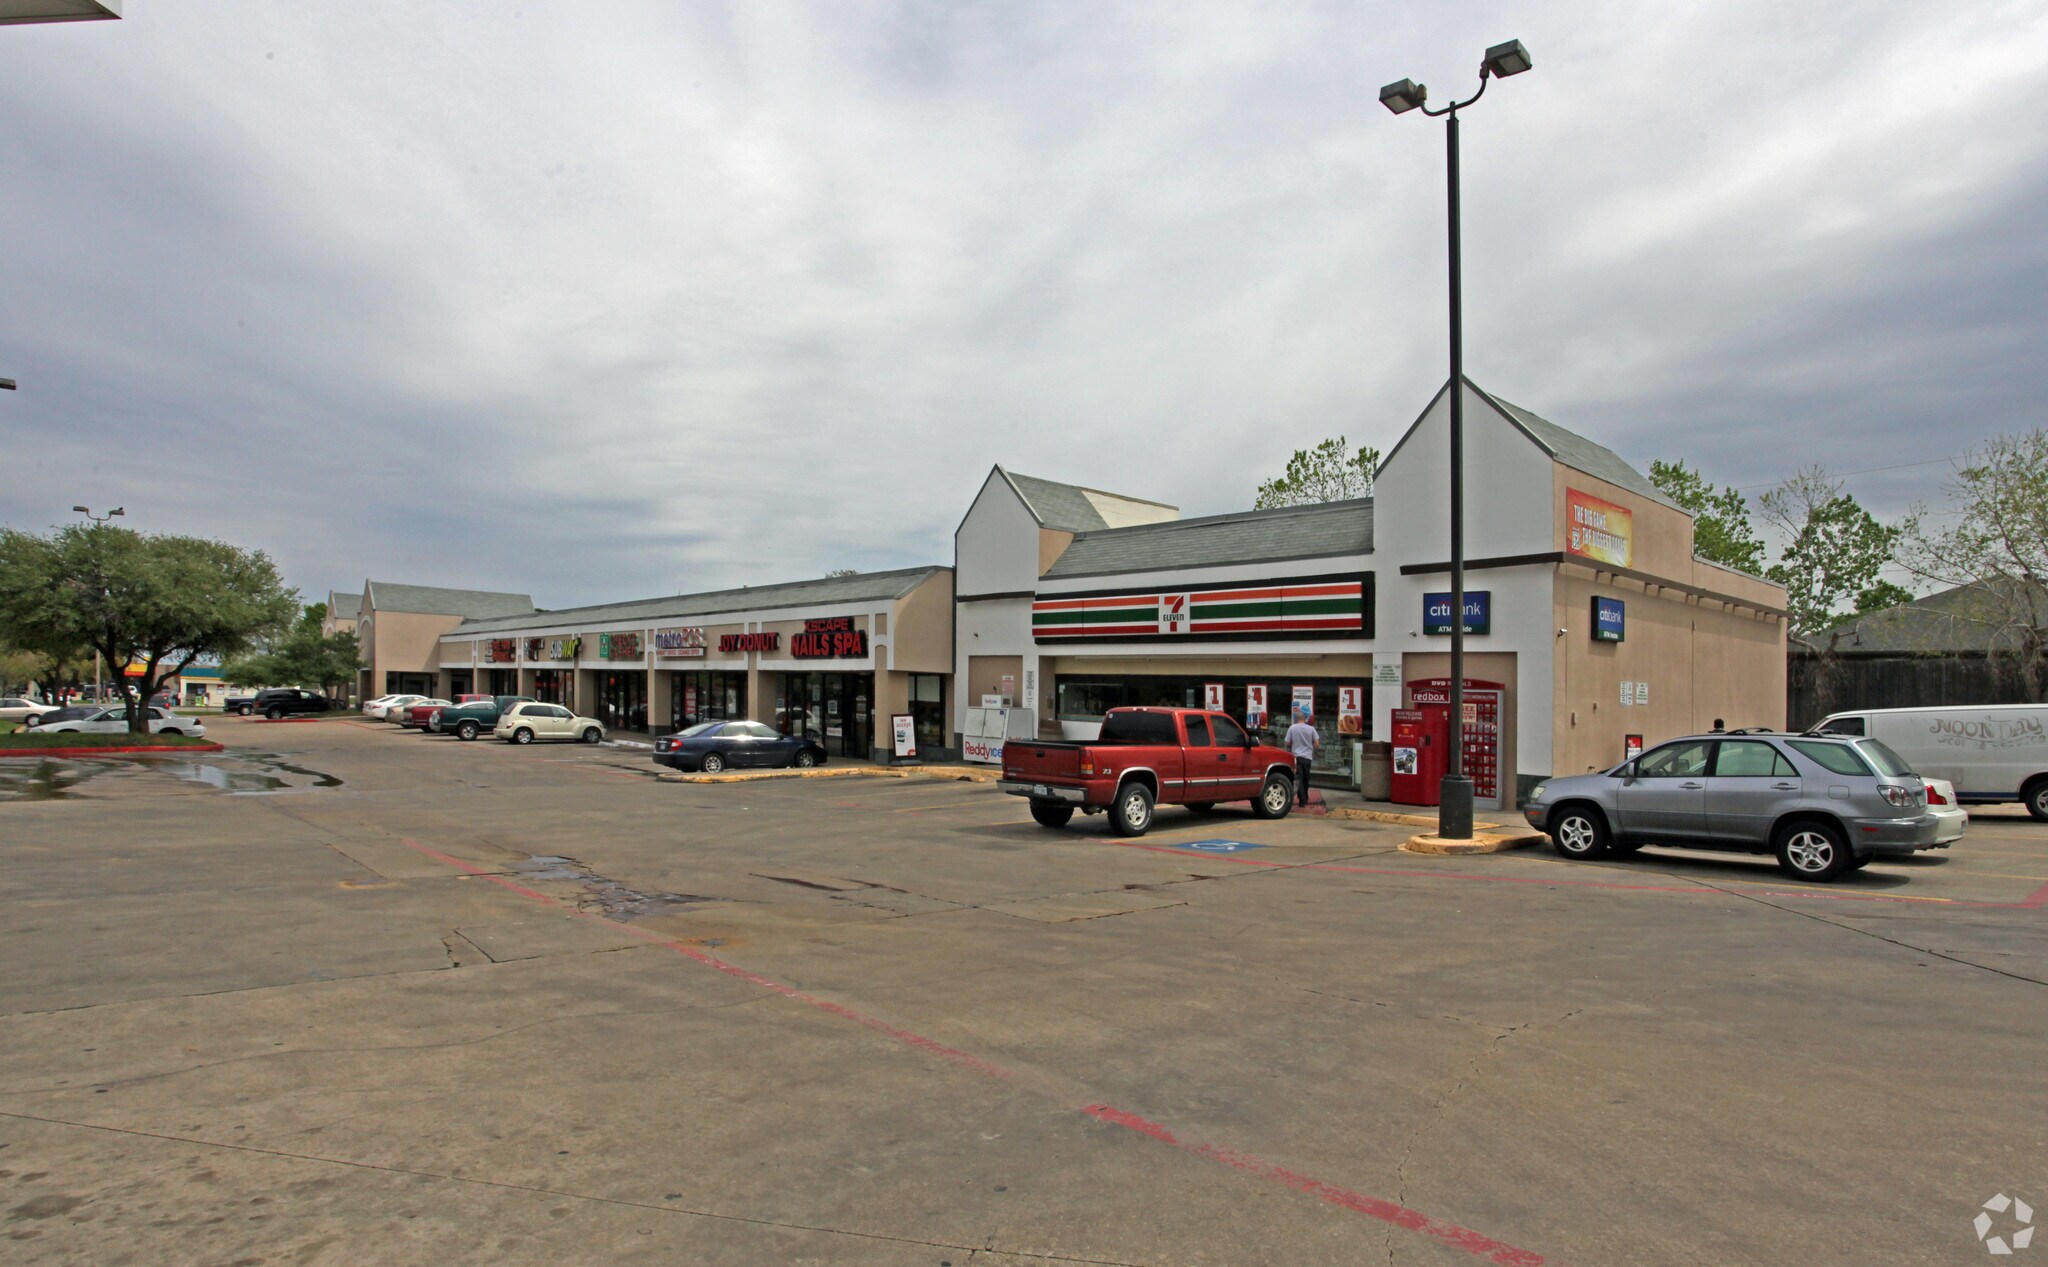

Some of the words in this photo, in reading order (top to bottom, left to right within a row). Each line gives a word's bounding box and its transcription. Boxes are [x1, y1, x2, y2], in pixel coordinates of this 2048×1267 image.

[1164, 595, 1184, 632] 7
[1600, 609, 1621, 623] citibank
[804, 618, 848, 632] XSCAPE
[550, 639, 578, 660] SUBWAY
[718, 634, 737, 652] JOY
[738, 632, 777, 651] DONUT
[791, 633, 829, 656] NAILS
[833, 631, 862, 655] SPA
[1413, 692, 1445, 701] redbox
